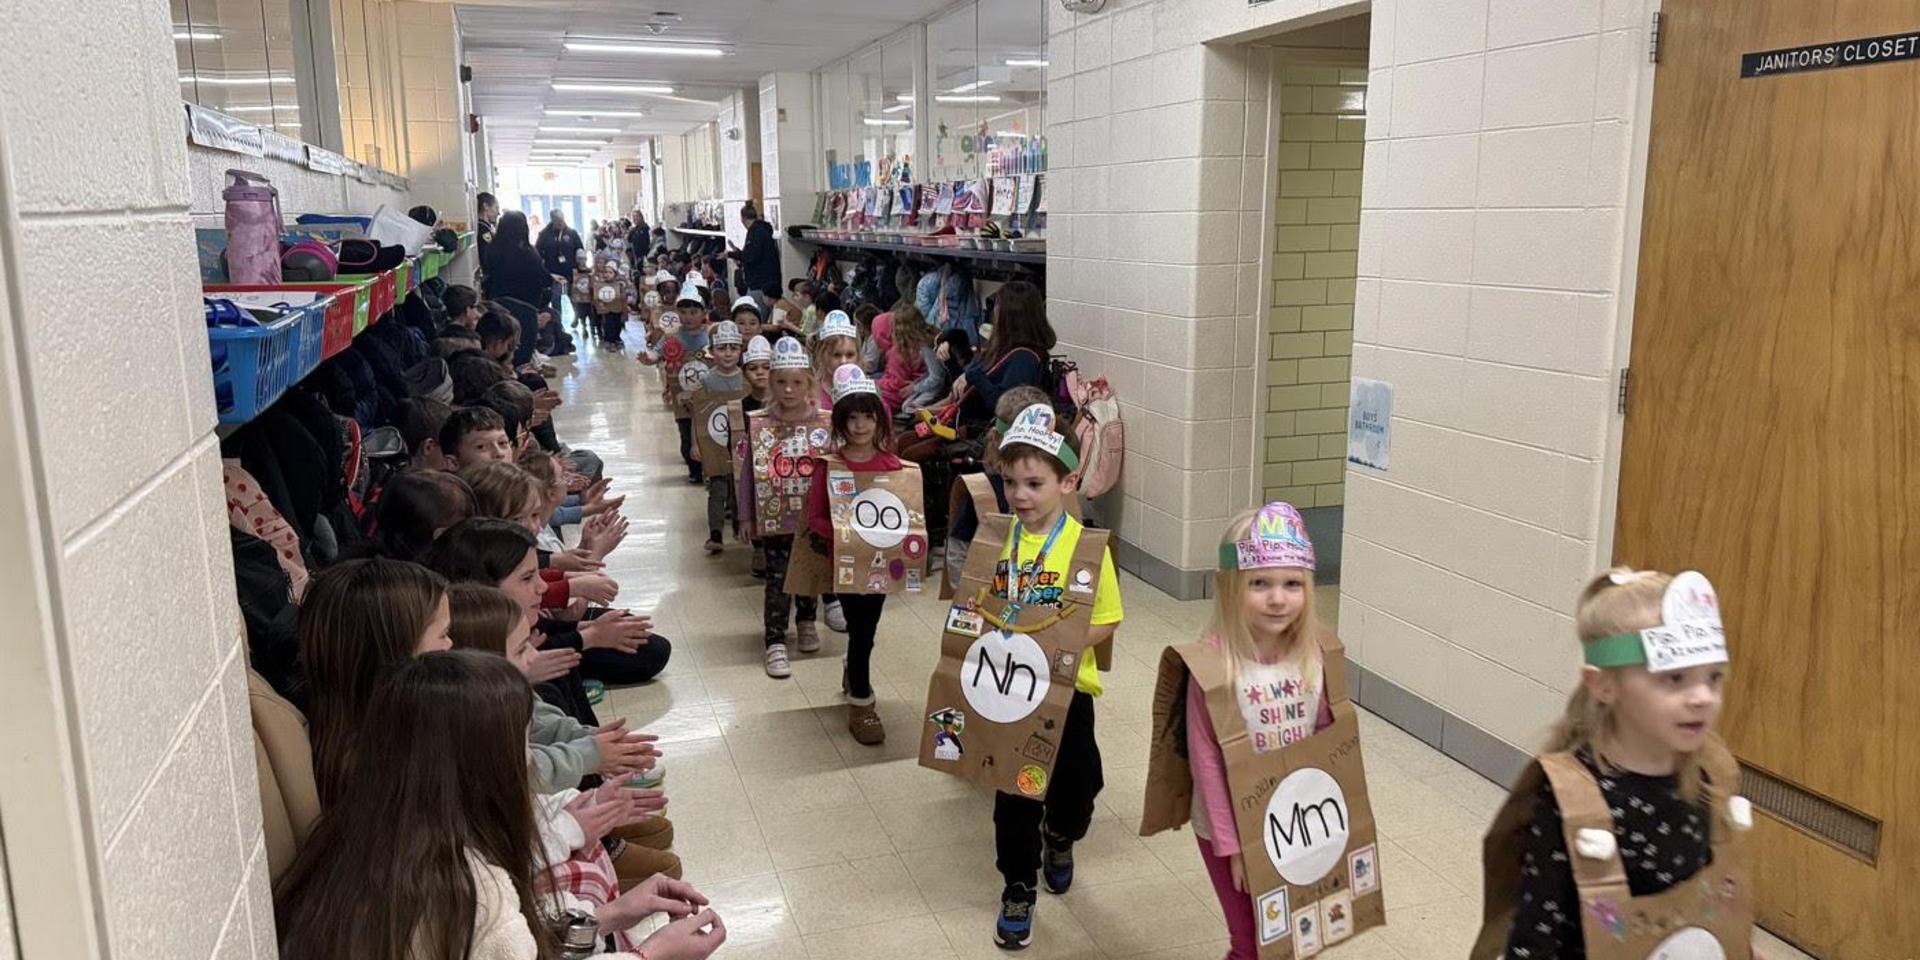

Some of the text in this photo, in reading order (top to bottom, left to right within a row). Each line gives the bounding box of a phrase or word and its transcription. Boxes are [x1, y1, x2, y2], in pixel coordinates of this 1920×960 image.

[1755, 36, 1919, 72] JANITORS' CLOSET
[855, 500, 902, 530] Oo
[972, 646, 1036, 702] Nn
[1260, 701, 1305, 724] SHNE
[1269, 797, 1345, 859] Mm
